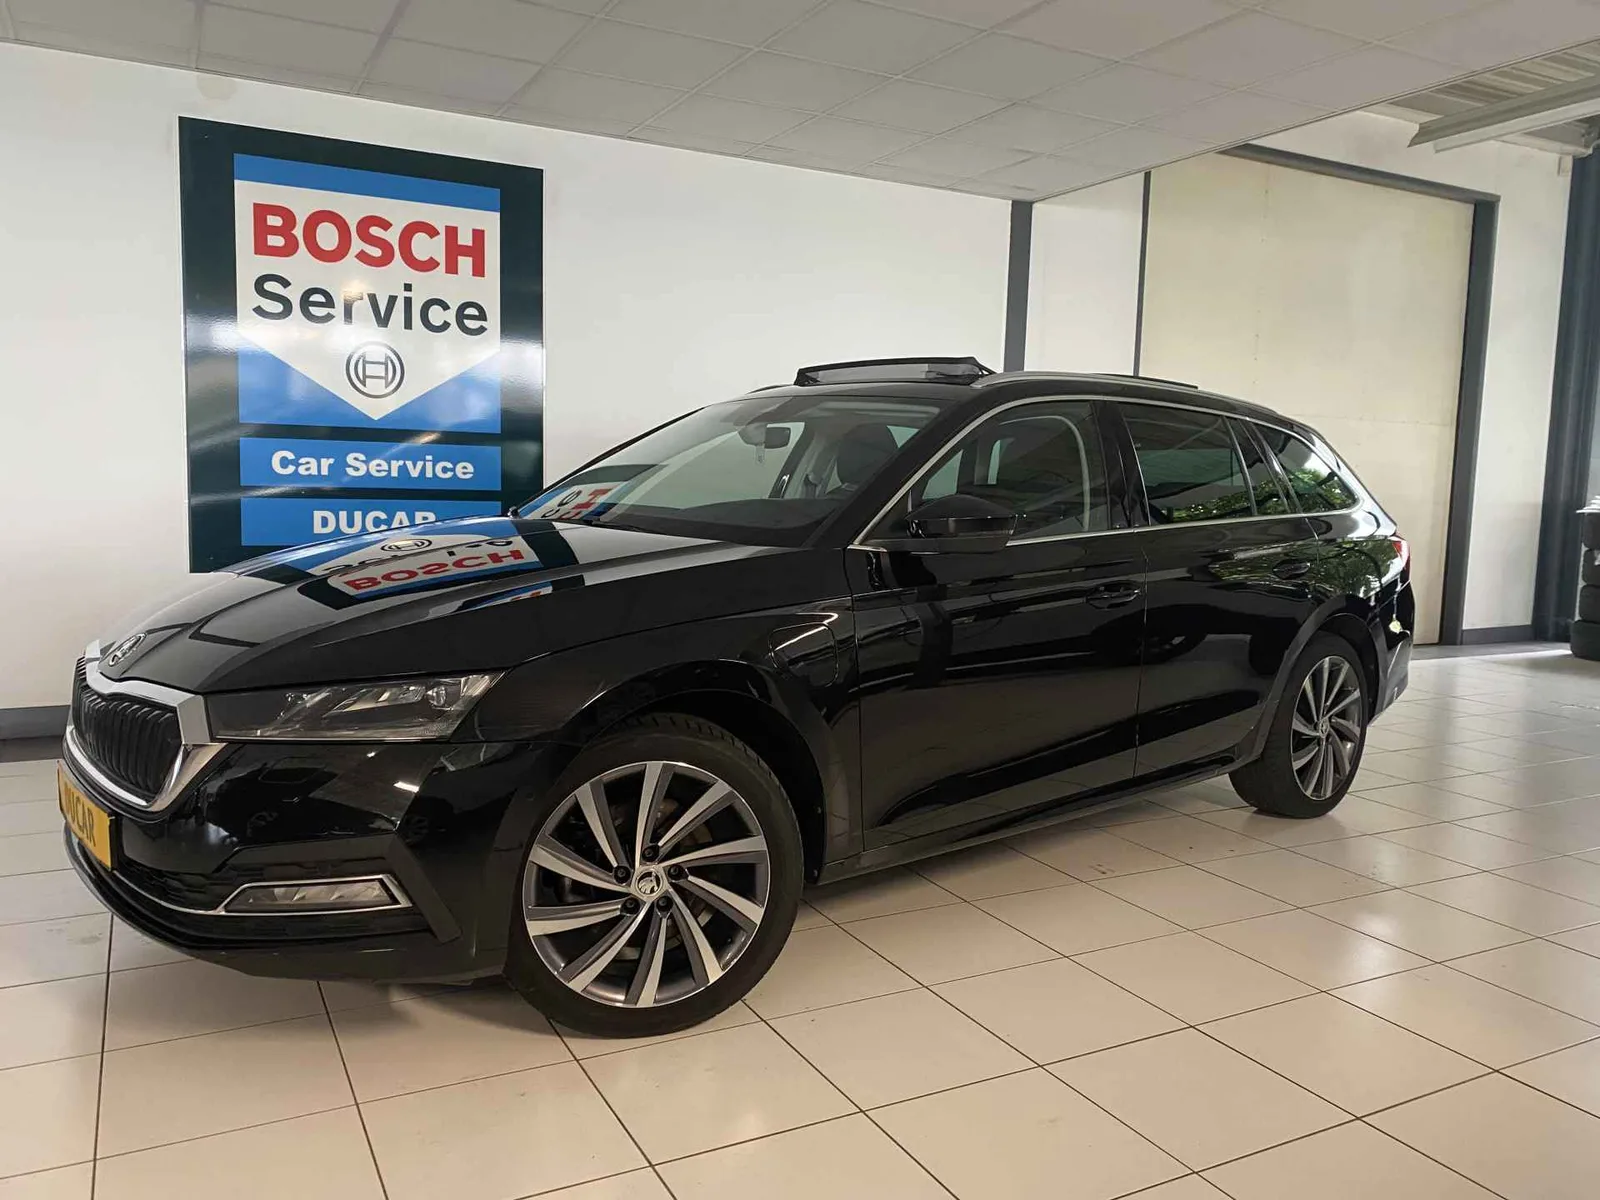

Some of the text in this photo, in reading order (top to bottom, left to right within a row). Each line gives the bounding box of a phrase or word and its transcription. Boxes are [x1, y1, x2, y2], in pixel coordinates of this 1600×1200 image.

[253, 203, 485, 278] BOSCH
[252, 273, 488, 336] Service
[271, 450, 475, 479] Car Service
